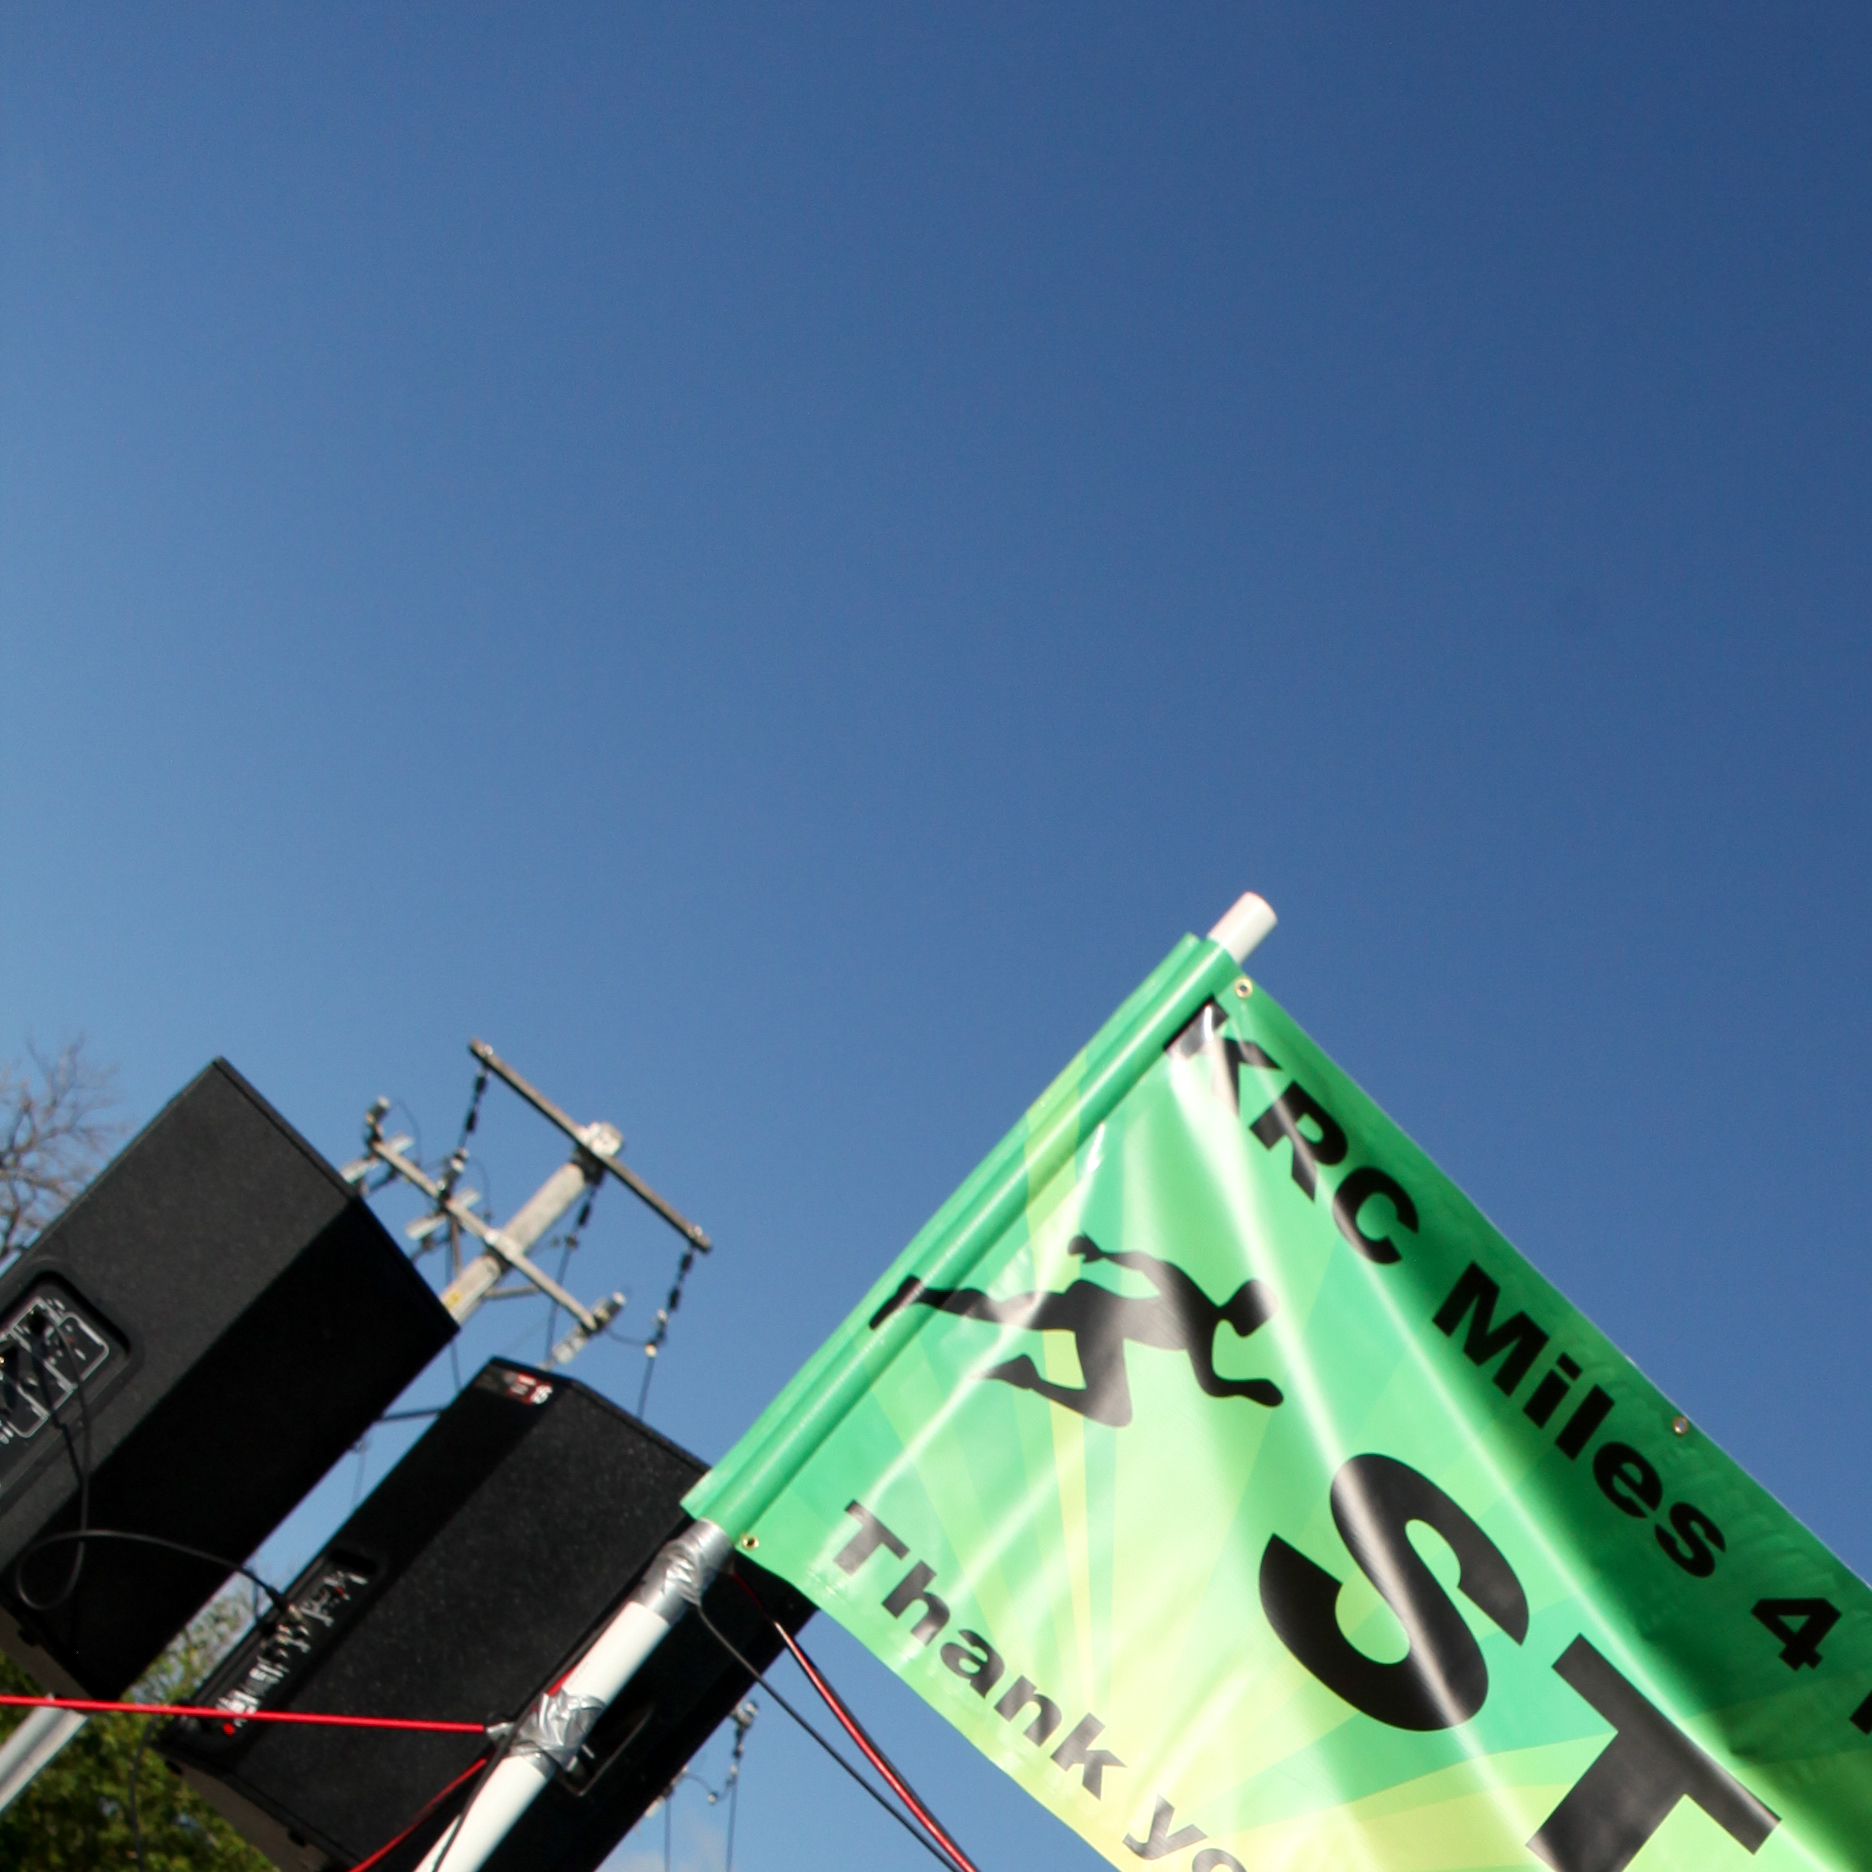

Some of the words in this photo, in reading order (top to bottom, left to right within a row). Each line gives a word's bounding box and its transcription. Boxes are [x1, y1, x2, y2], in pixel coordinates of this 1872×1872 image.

[1163, 993, 1419, 1265] KRC
[1432, 1259, 1727, 1579] Miles
[1749, 1596, 1842, 1672] 4
[832, 1499, 1128, 1800] Thank
